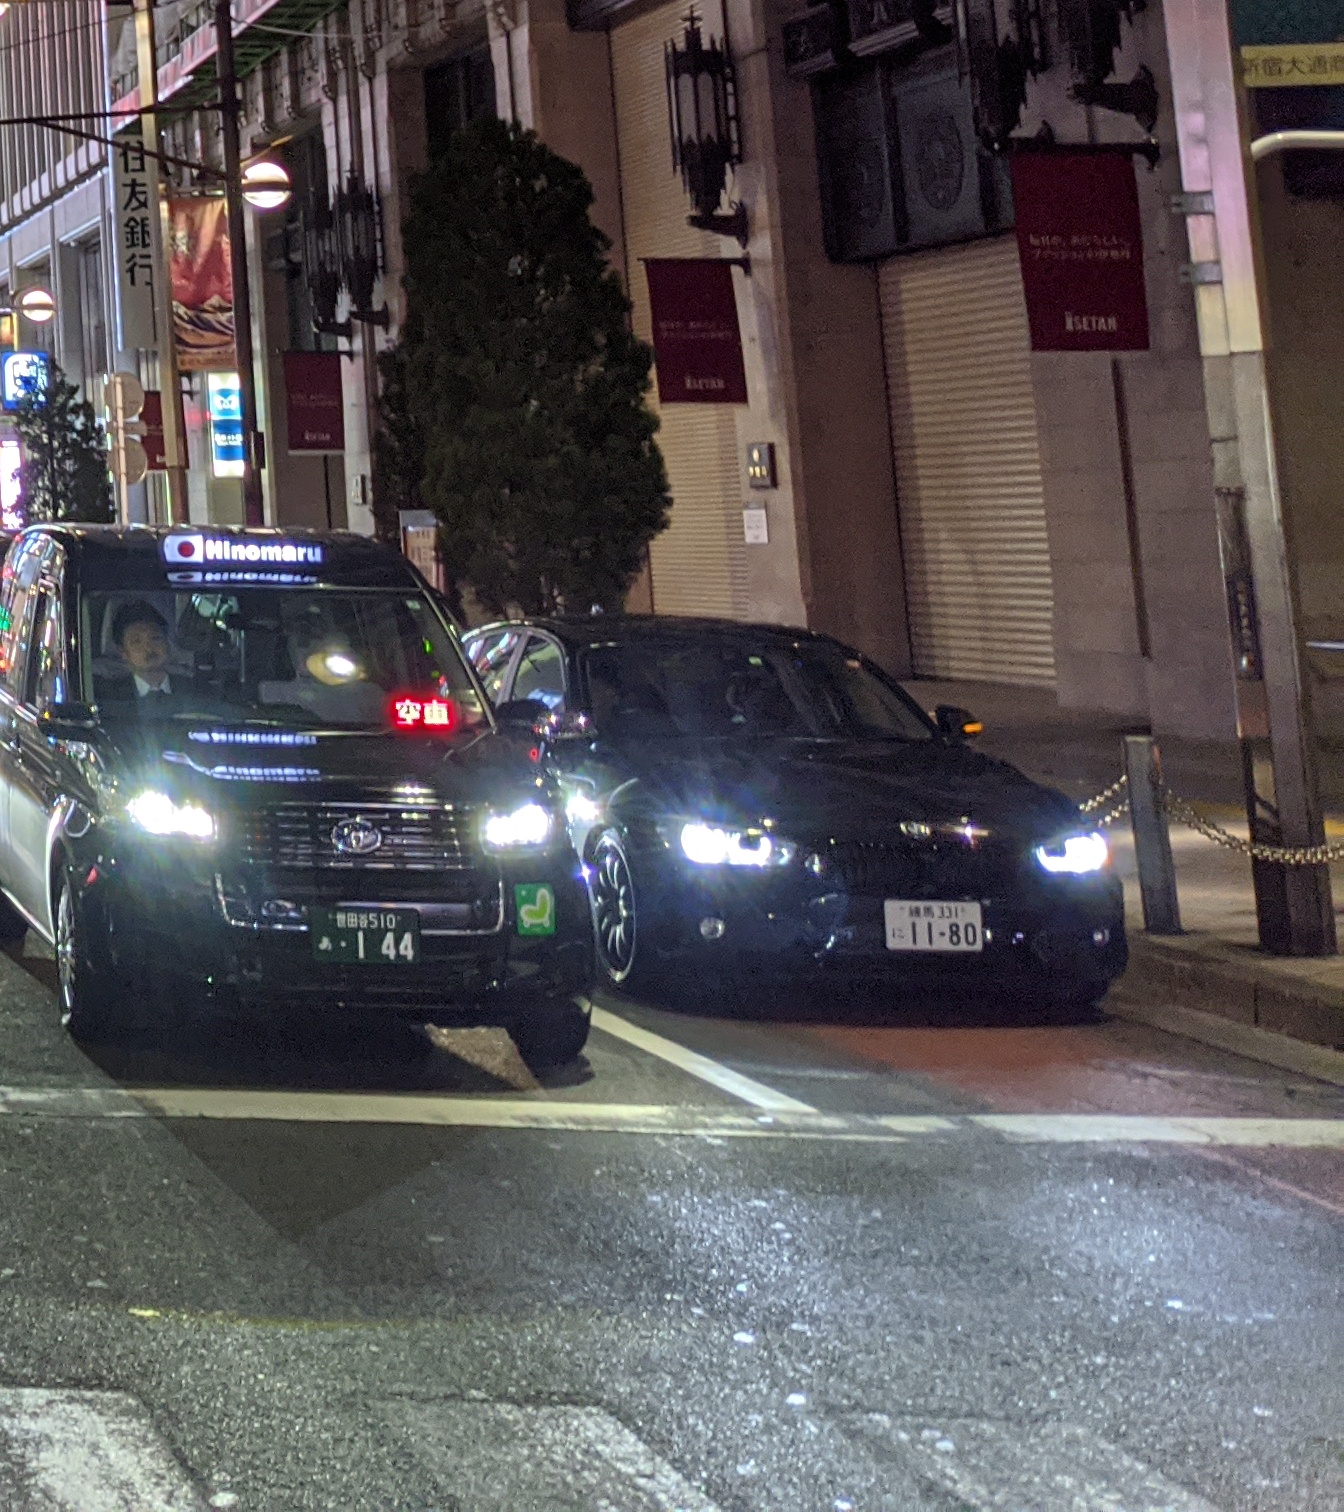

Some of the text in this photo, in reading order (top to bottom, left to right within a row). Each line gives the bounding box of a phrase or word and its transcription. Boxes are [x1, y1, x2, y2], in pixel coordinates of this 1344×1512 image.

[1064, 310, 1117, 332] ISETAN
[205, 539, 322, 563] Hinomaru
[911, 921, 977, 946] 11-80
